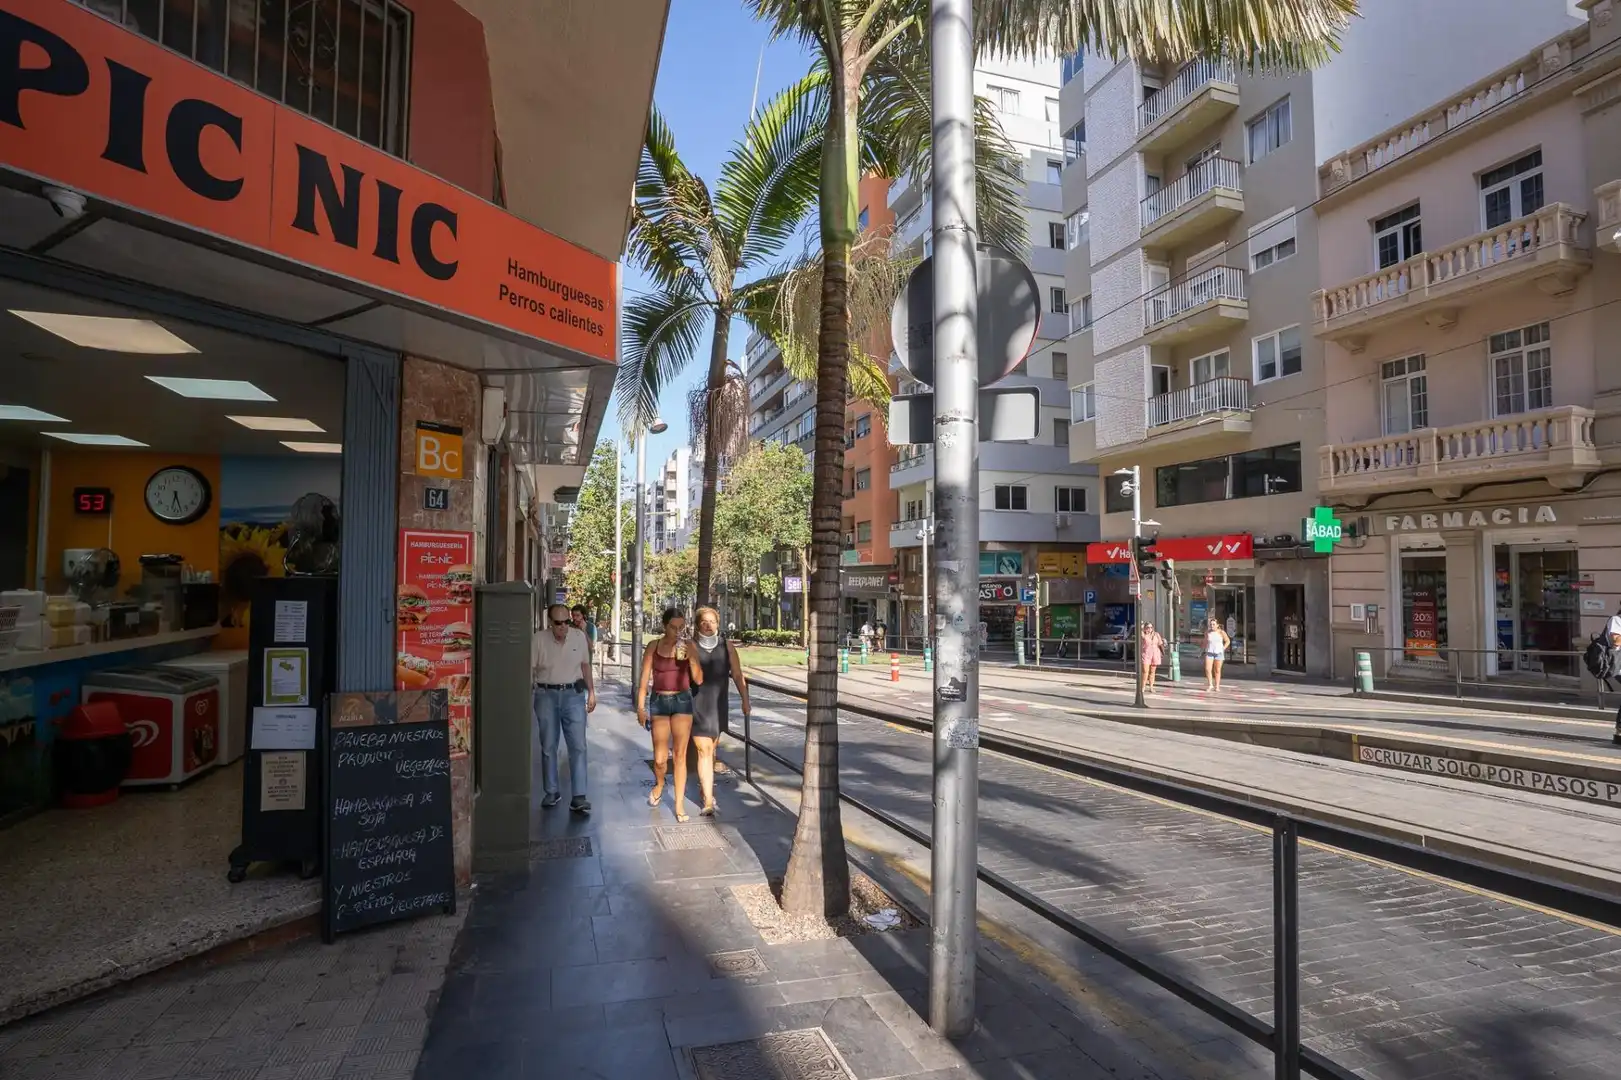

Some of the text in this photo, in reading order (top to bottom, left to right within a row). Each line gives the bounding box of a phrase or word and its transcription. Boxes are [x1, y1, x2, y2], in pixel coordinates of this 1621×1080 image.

[0, 11, 459, 281] PIC NIC
[507, 257, 604, 312] Hamburguesas
[499, 284, 604, 336] Perros calientes
[79, 494, 106, 511] 53
[428, 490, 444, 508] 64
[1385, 505, 1557, 530] FARMACIA
[1087, 592, 1094, 602] P
[333, 731, 387, 750] PRUEBA
[395, 757, 450, 774] VEGETALES
[1374, 749, 1432, 771] CRUZAR
[1437, 758, 1481, 778] SOLO
[1487, 766, 1526, 786] POR
[1532, 773, 1598, 797] PASOS
[419, 791, 433, 805] DE
[334, 884, 345, 905] Y
